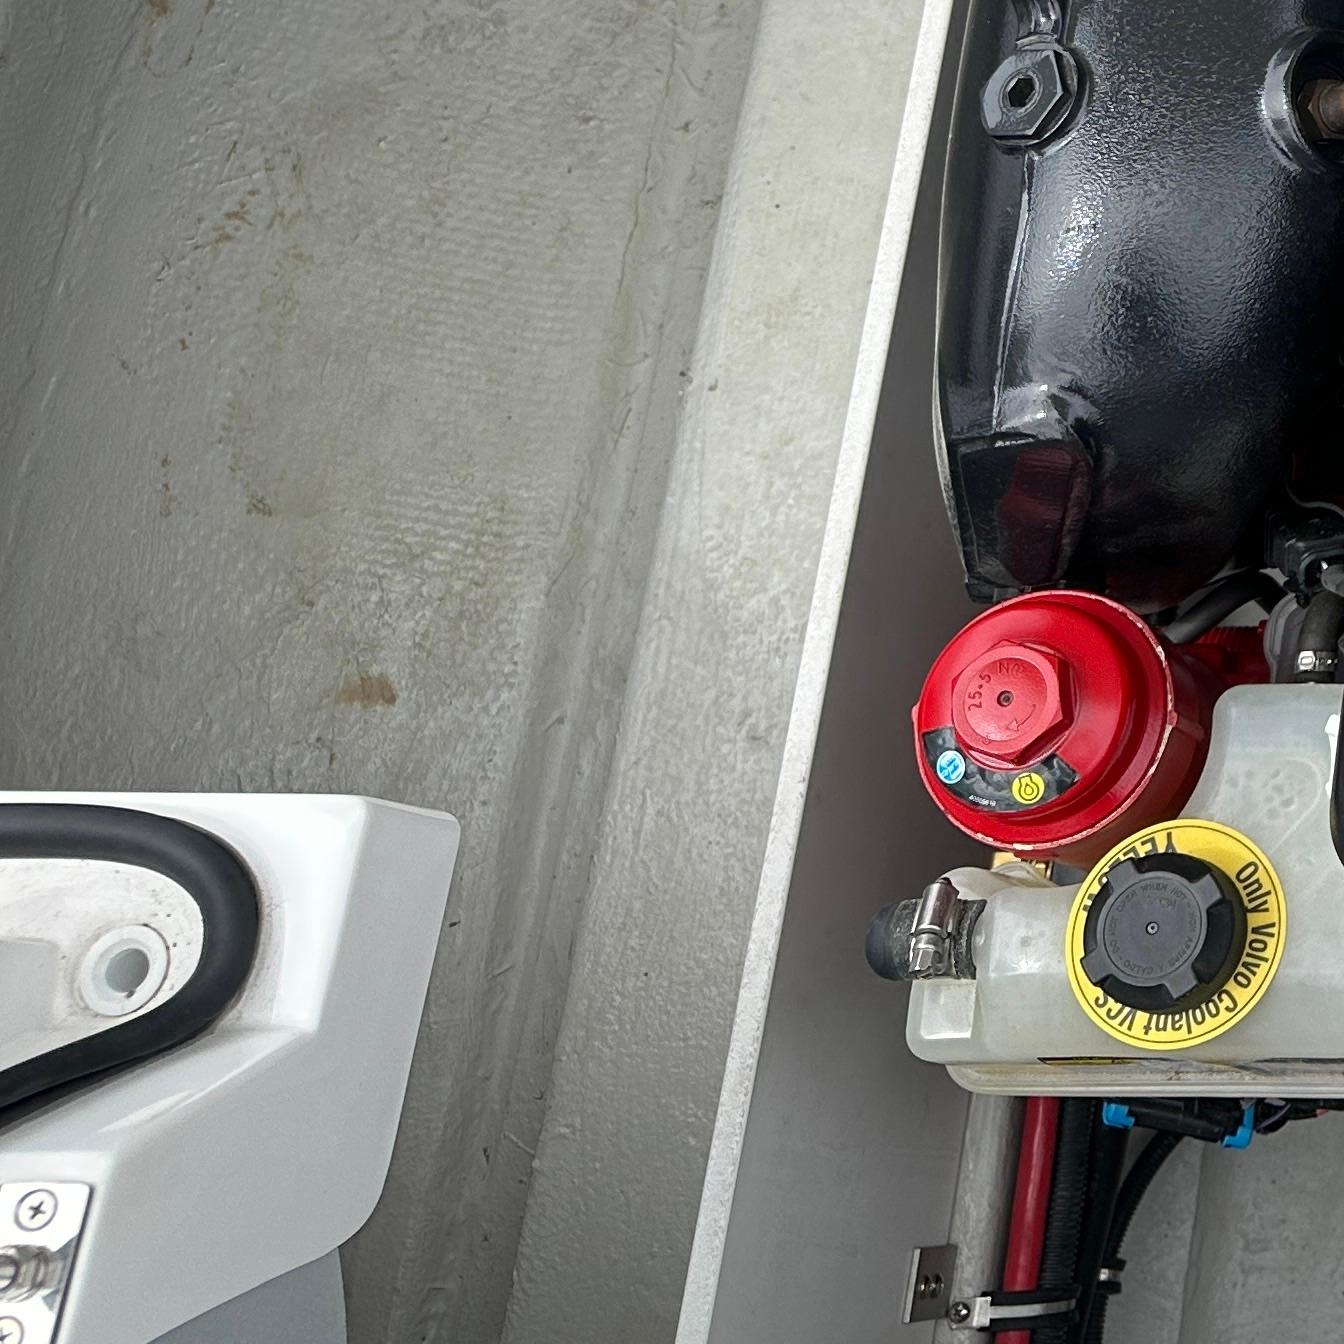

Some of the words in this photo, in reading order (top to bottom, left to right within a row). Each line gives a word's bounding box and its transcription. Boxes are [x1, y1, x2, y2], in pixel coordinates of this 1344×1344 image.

[1237, 861, 1272, 913] Only
[1233, 922, 1276, 988] Volvo
[1093, 995, 1134, 1031] VCS
[1143, 991, 1239, 1035] Coolant
